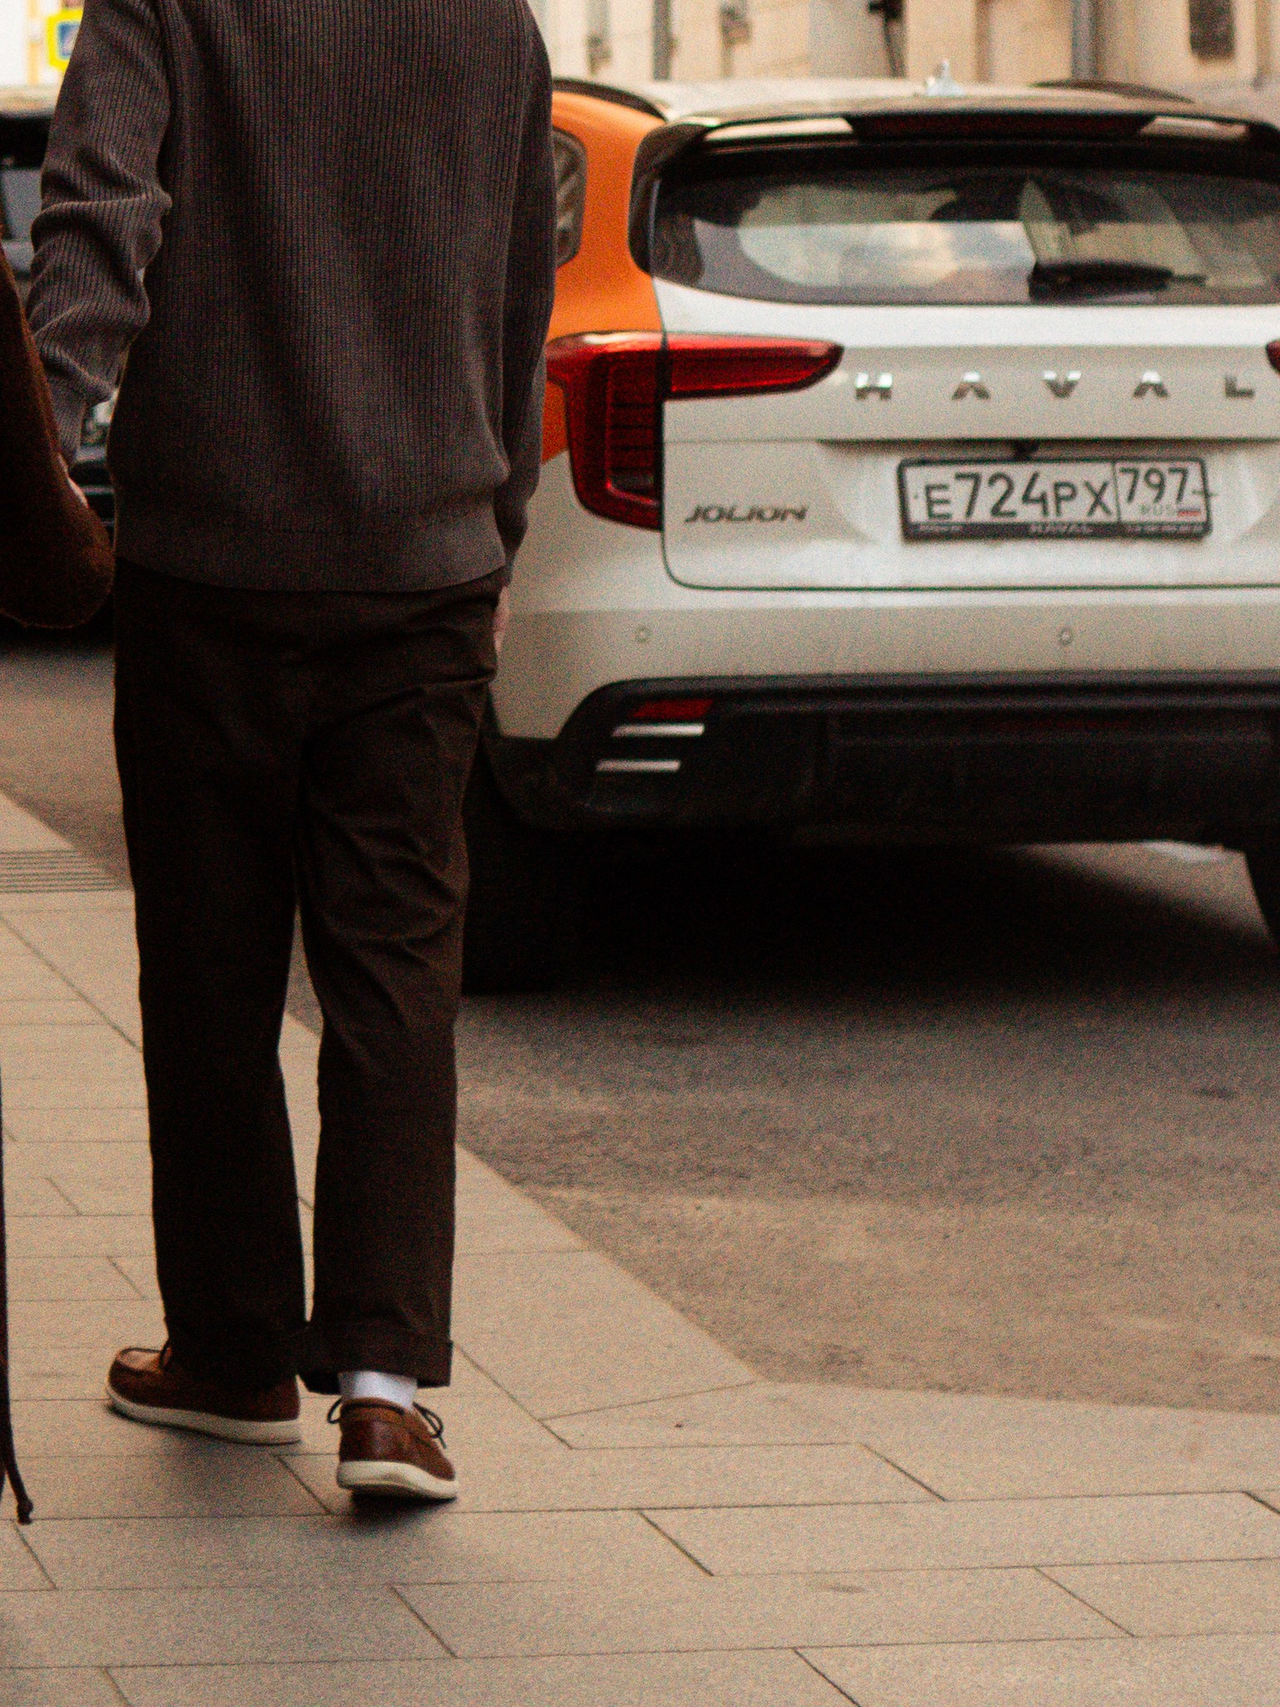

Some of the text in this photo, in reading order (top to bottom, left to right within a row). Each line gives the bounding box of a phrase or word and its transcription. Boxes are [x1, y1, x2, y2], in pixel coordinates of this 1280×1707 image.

[855, 371, 1256, 401] HAVAL
[1119, 466, 1188, 504] 797
[683, 503, 809, 523] JOLION
